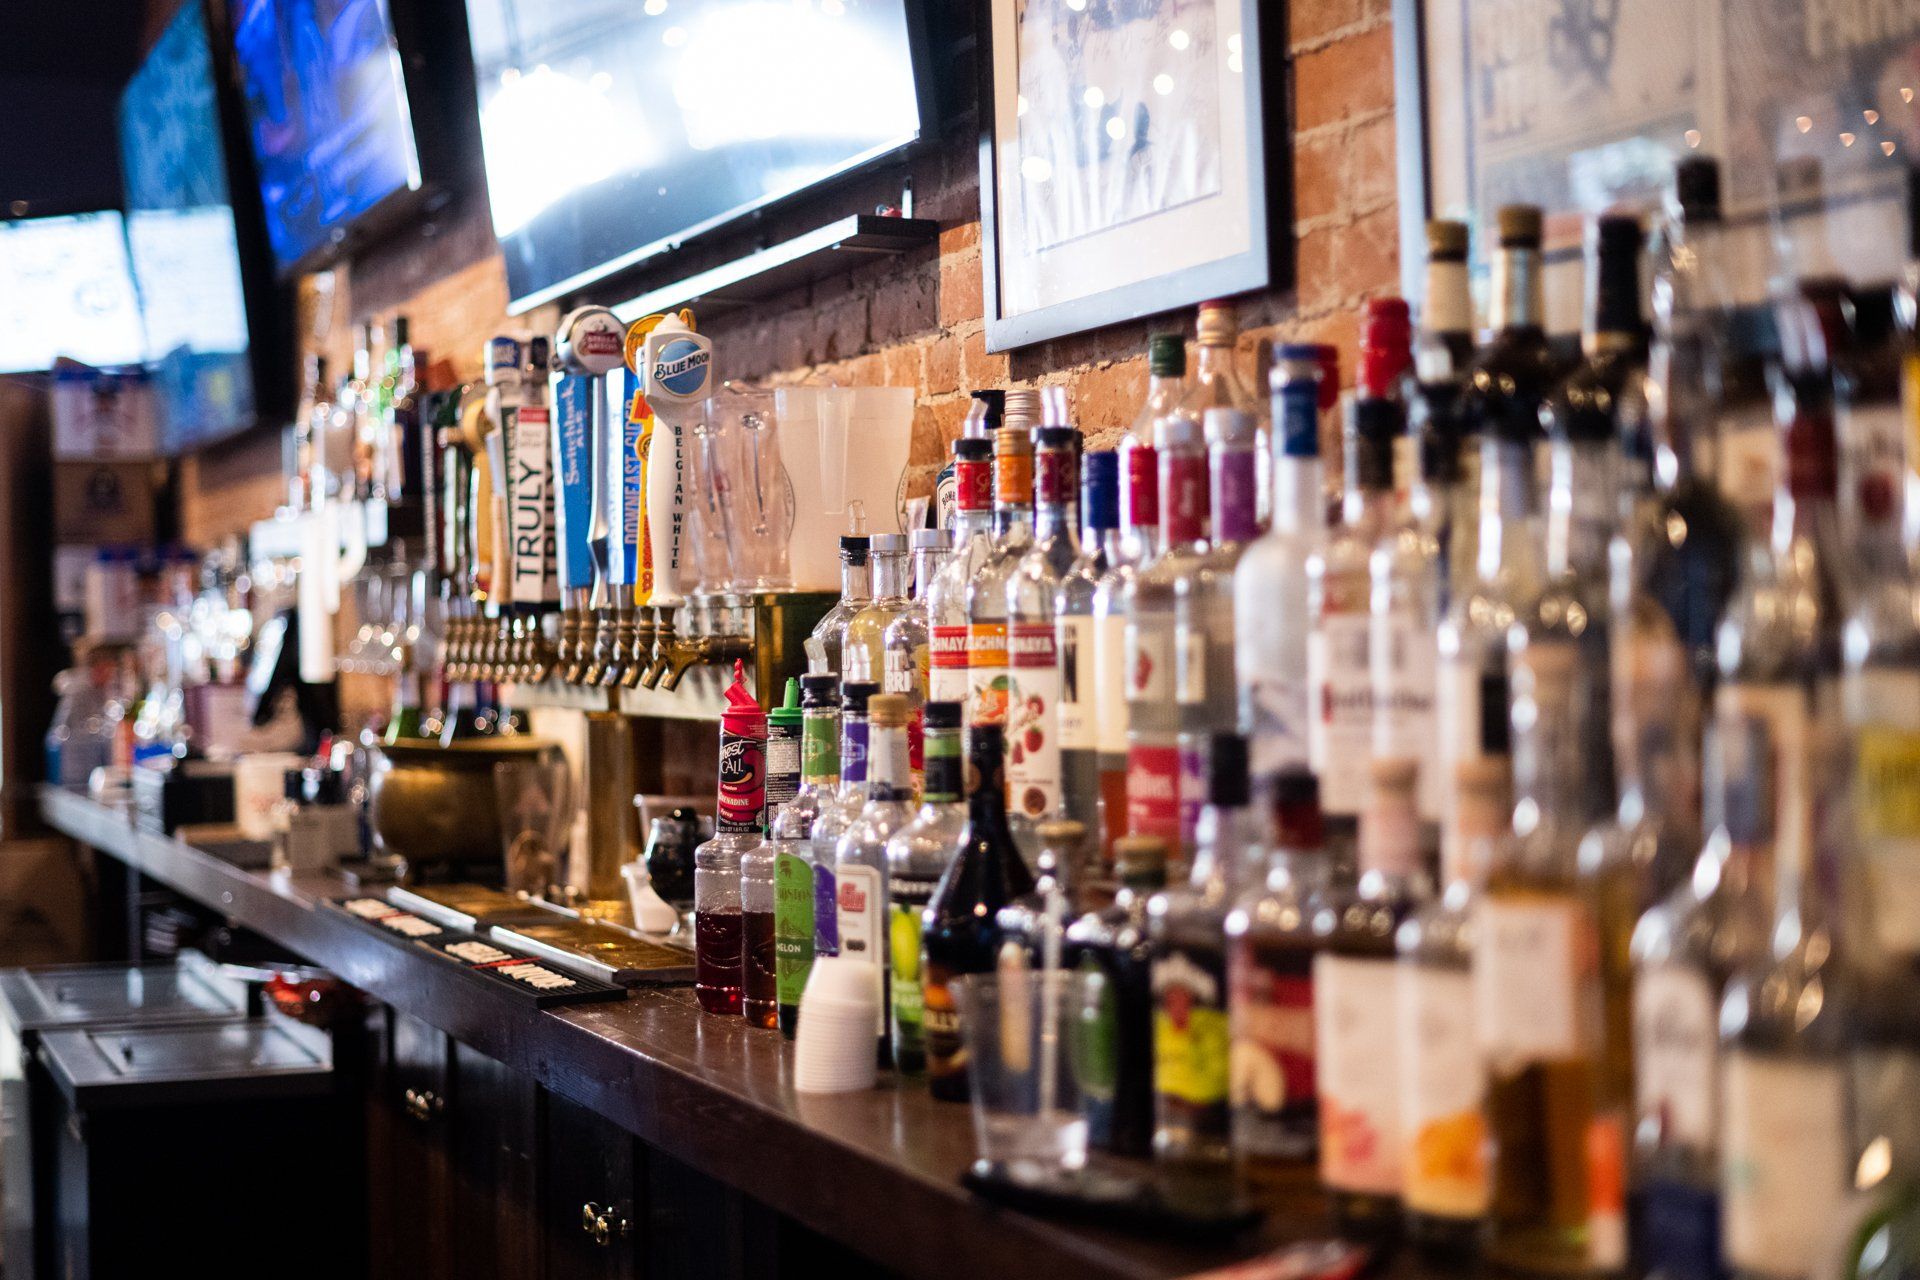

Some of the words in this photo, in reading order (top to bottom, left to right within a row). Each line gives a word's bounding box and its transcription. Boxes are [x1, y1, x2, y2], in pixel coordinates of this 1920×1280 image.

[654, 360, 686, 380] BLUE
[687, 350, 710, 367] MOON
[674, 425, 684, 505] BELGIAN
[515, 460, 543, 583] TRULY
[623, 456, 642, 545] DOWNEAST
[671, 512, 684, 569] WHITE
[720, 757, 744, 775] CALL
